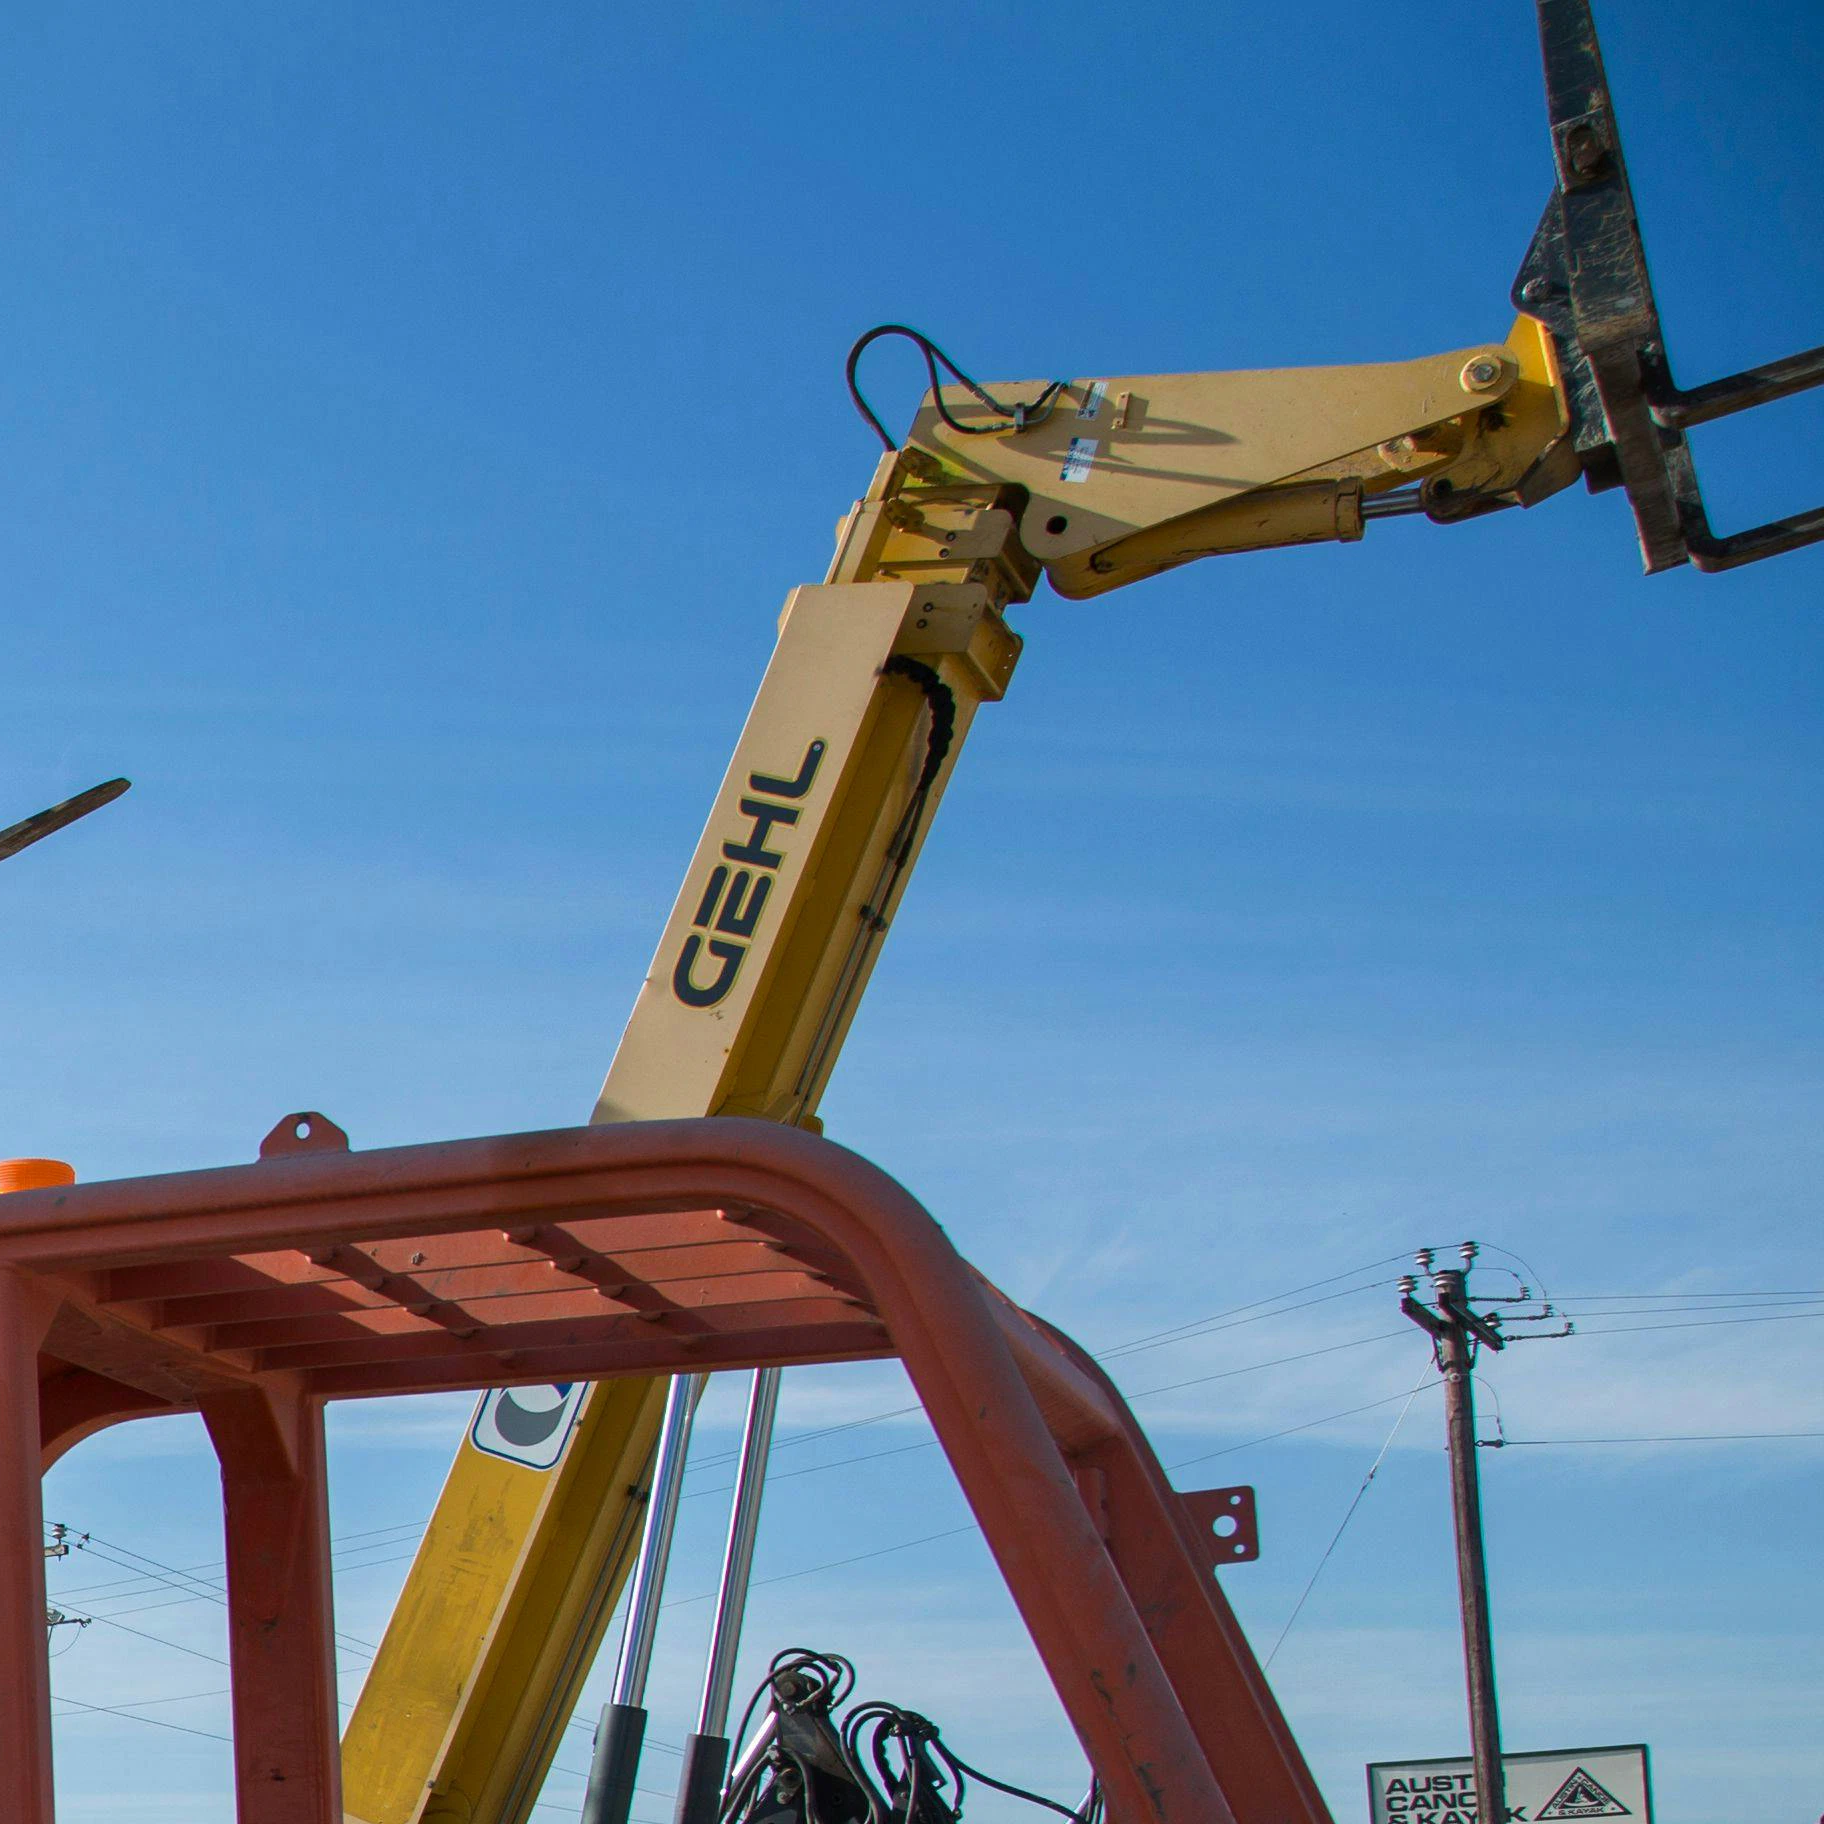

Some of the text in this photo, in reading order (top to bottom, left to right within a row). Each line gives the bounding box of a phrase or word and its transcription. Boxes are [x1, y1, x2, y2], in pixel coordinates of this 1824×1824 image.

[672, 738, 827, 1008] GEHL
[1386, 1772, 1505, 1794] AUST
[1385, 1791, 1477, 1813] CANO
